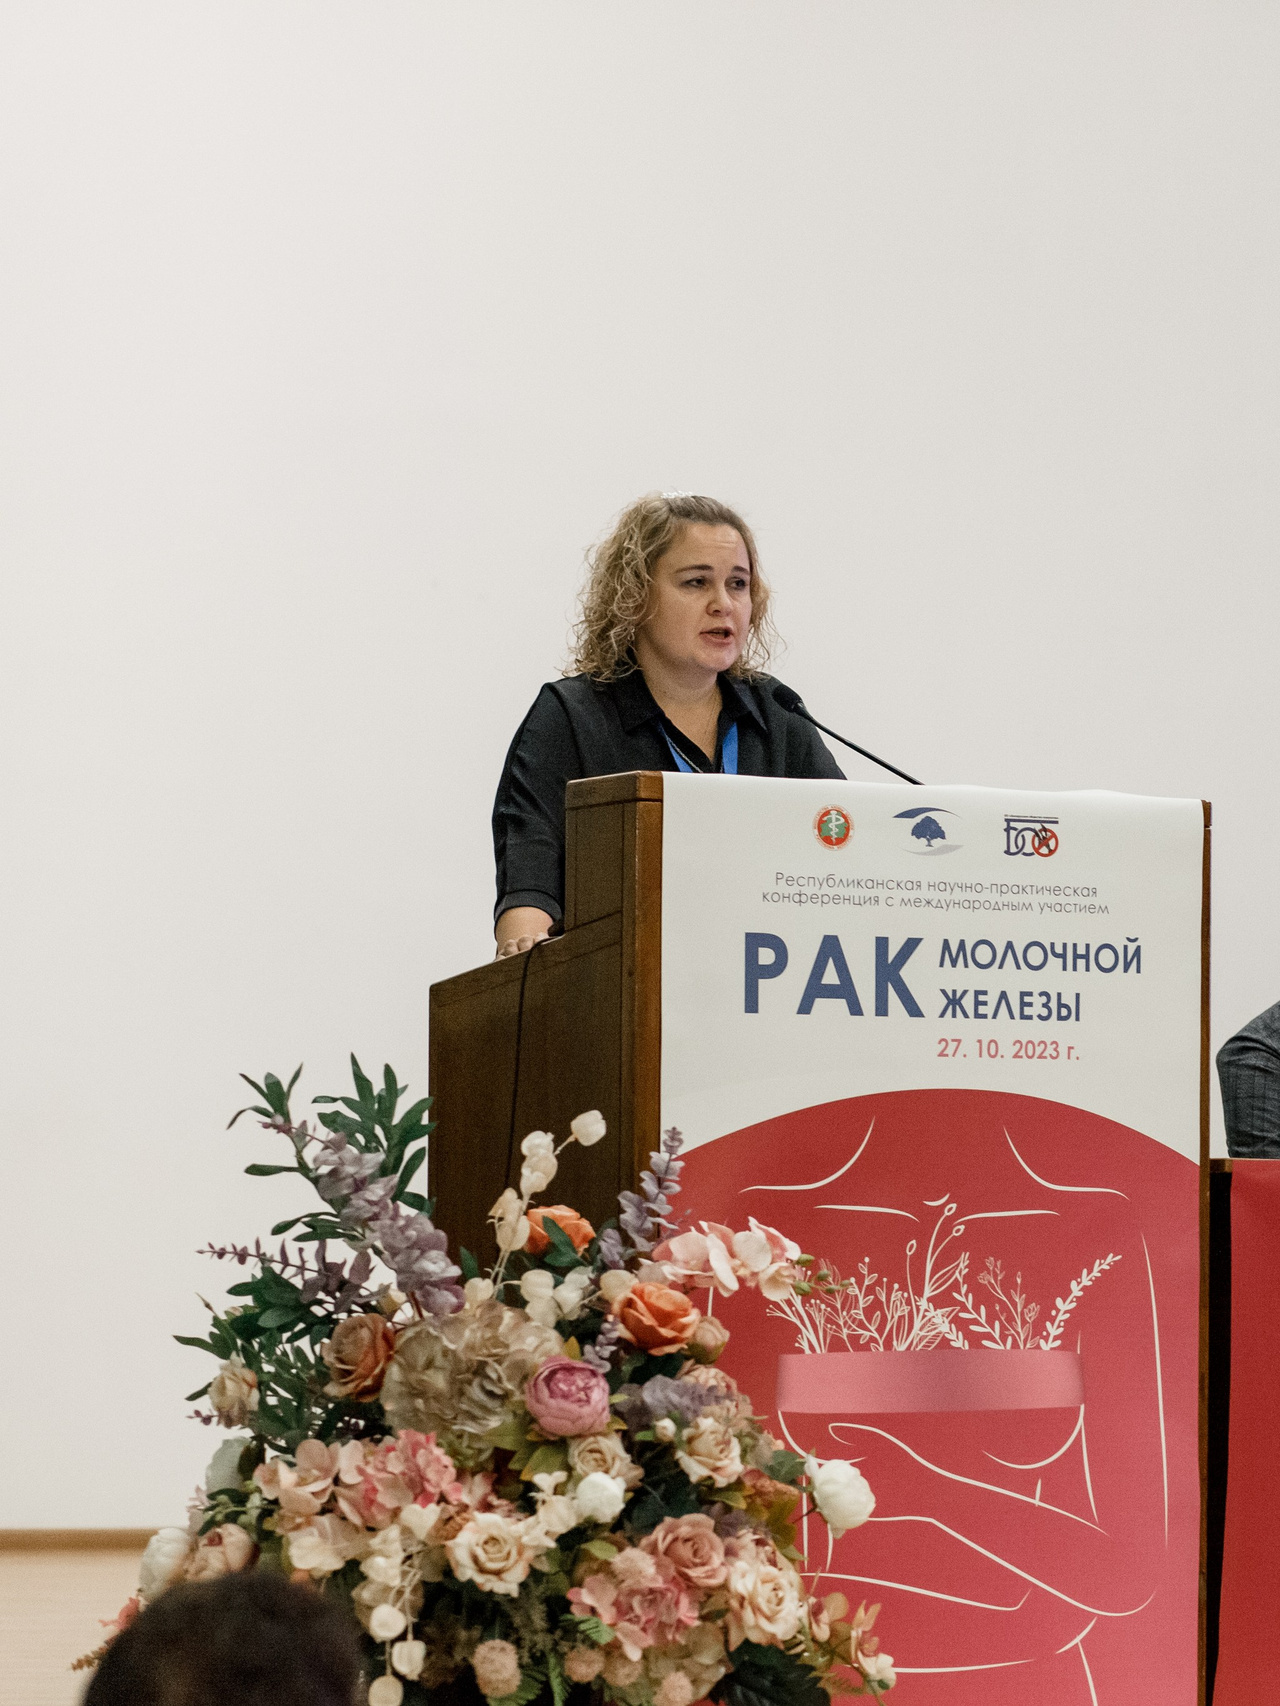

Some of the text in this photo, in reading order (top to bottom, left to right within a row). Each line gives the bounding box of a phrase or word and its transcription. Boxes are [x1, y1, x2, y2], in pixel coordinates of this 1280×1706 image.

[775, 871, 1098, 898] Республиканская научно-практическая
[762, 889, 1110, 915] конференция с международным участием
[938, 936, 1142, 974] МОЛОЧНОЙ
[744, 931, 926, 1018] РАК
[938, 988, 1081, 1022] ЖЕЛЕЗЫ
[936, 1037, 1080, 1061] 27. 10. 2023 г.
